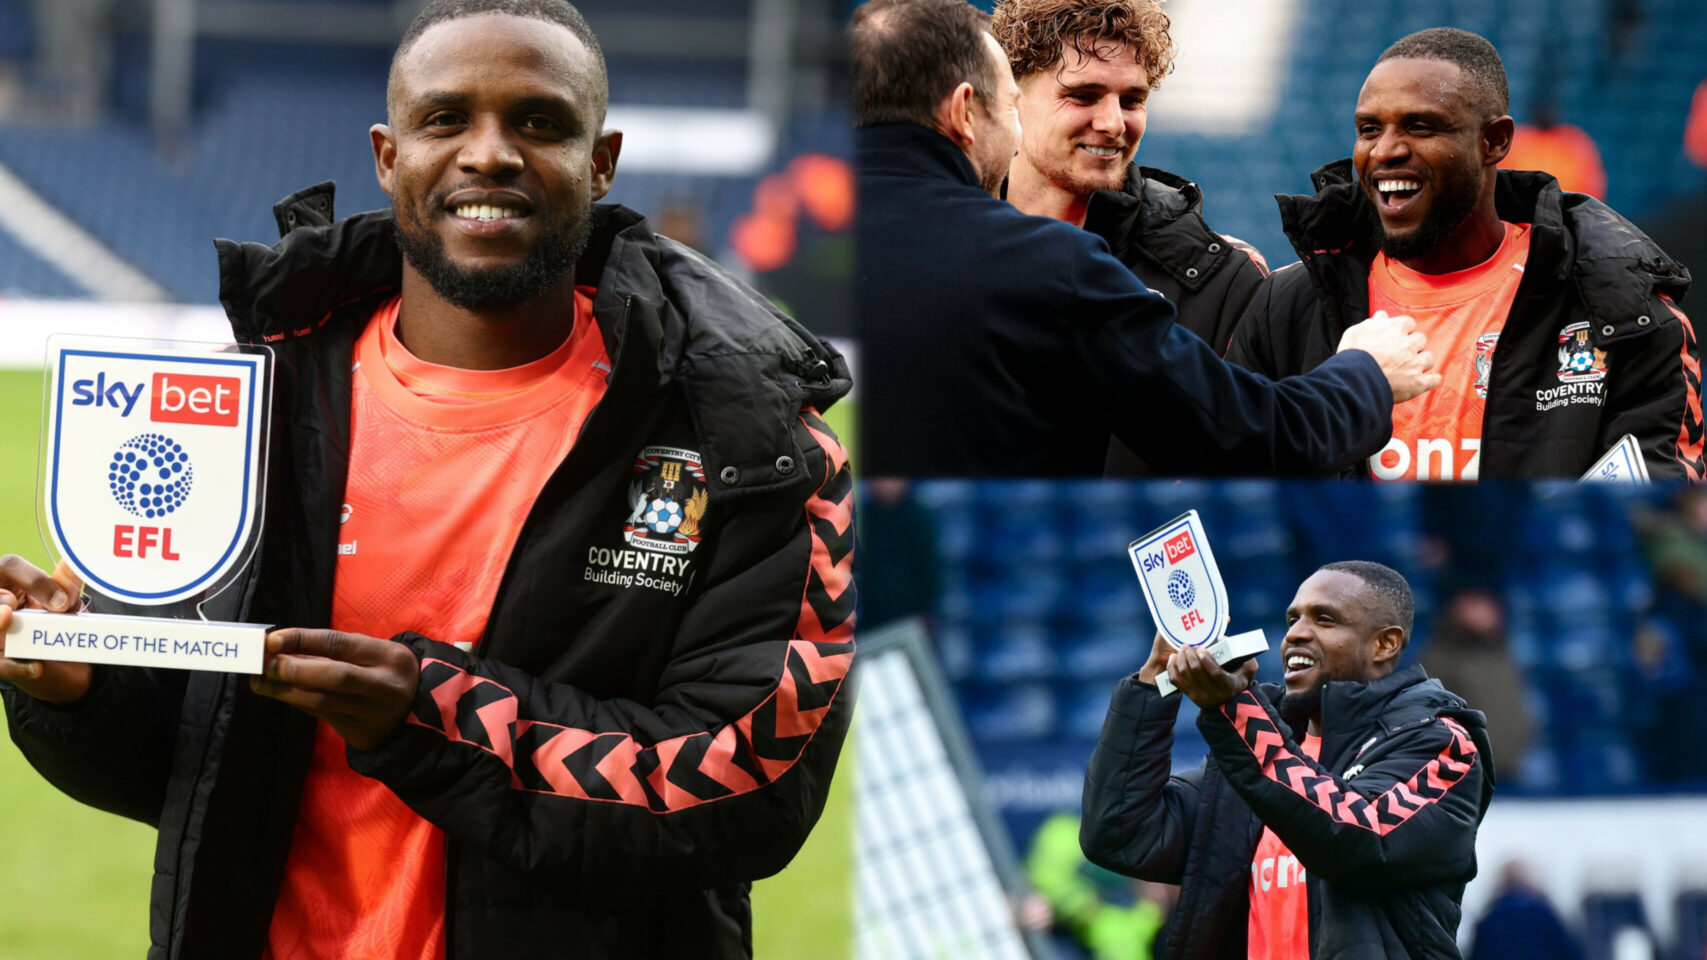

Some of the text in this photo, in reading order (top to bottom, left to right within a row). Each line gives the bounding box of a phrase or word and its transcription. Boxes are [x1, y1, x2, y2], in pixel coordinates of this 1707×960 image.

[72, 372, 230, 417] sky bet
[1536, 382, 1603, 401] COVENTRY
[1536, 395, 1602, 411] Building Society
[646, 448, 685, 457] COVENTRY
[113, 525, 180, 561] EFL
[632, 538, 687, 552] FOOTBALL CLUB
[1143, 536, 1192, 572] sky bet
[588, 546, 690, 577] COVENTRY
[584, 567, 683, 596] Building Society
[1180, 609, 1205, 631] EFL
[32, 630, 238, 658] PLAYER OF THE MATCH
